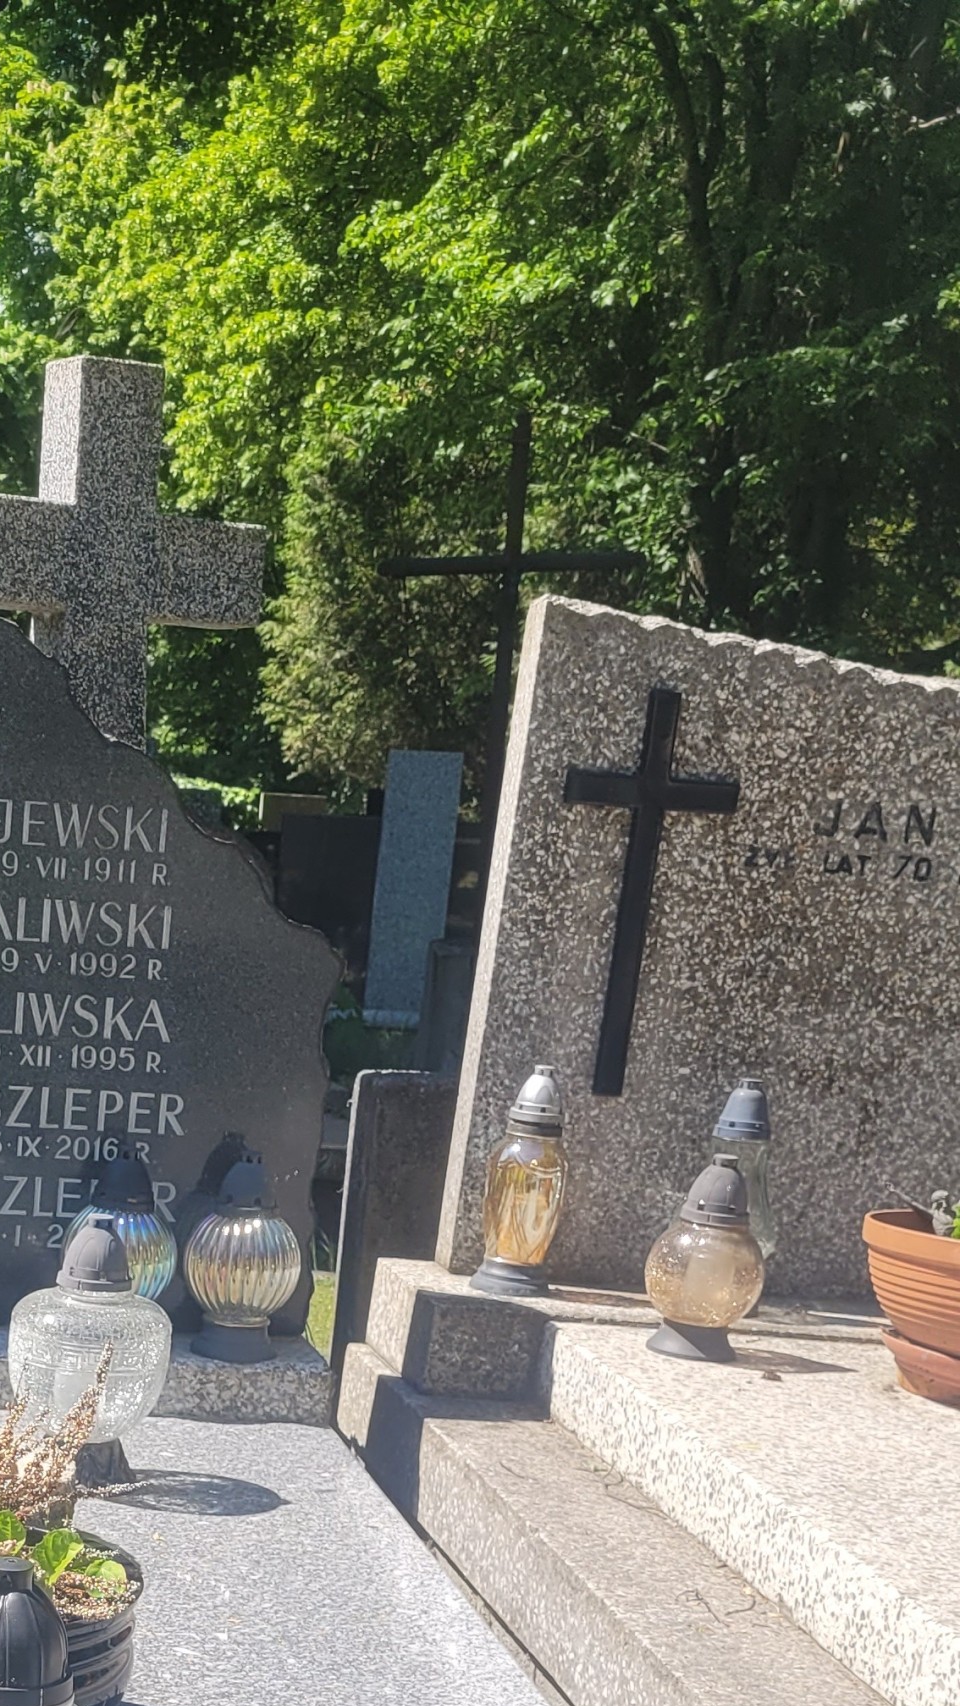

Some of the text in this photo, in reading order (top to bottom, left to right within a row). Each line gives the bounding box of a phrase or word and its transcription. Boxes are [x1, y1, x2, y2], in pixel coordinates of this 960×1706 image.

[813, 799, 937, 847] JAN
[152, 863, 170, 886] R.
[823, 850, 871, 876] LAT
[892, 855, 932, 882] 70
[148, 958, 167, 981] R.
[146, 1051, 167, 1074] R.
